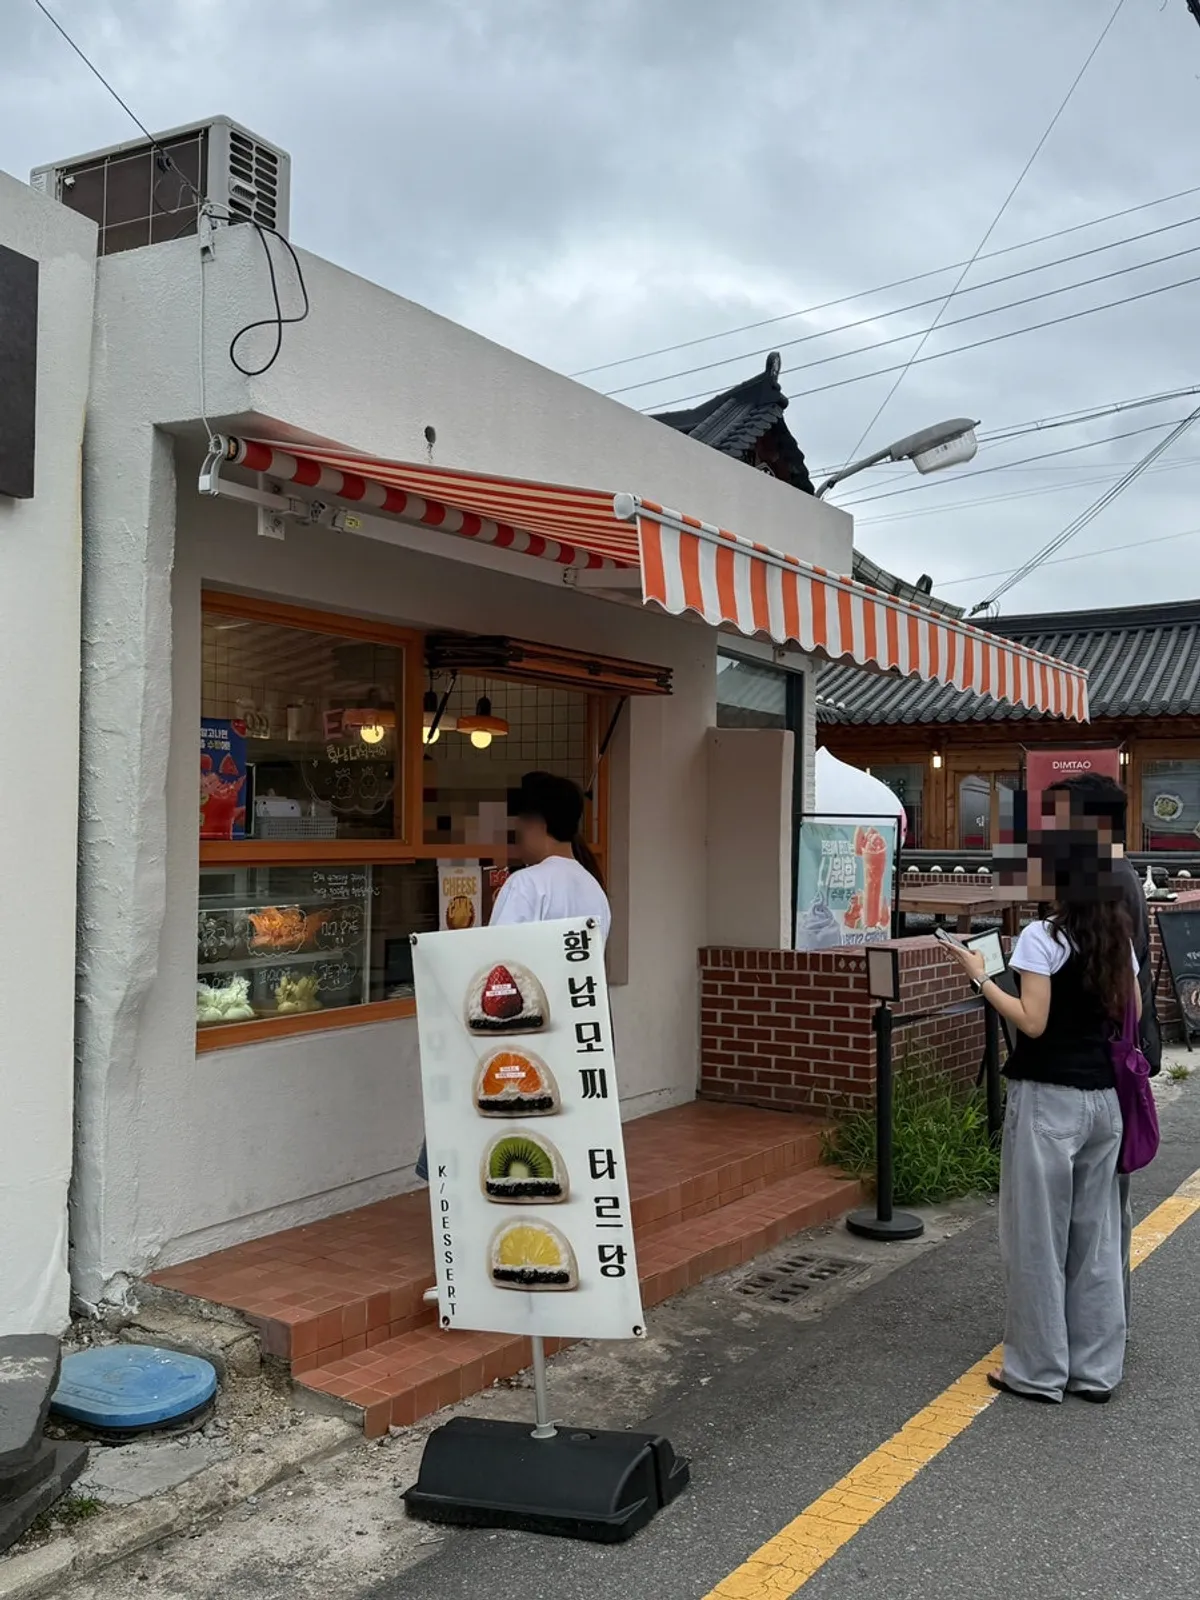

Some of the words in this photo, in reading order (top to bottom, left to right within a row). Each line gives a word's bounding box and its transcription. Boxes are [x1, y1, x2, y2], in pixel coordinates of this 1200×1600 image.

[1052, 760, 1092, 770] DIMTAO
[443, 875, 478, 897] CHEESE
[448, 896, 475, 920] CAKE
[563, 929, 608, 1099] 황남모찌
[589, 1148, 627, 1278] 타르당
[438, 1164, 457, 1316] K/DESSERT
